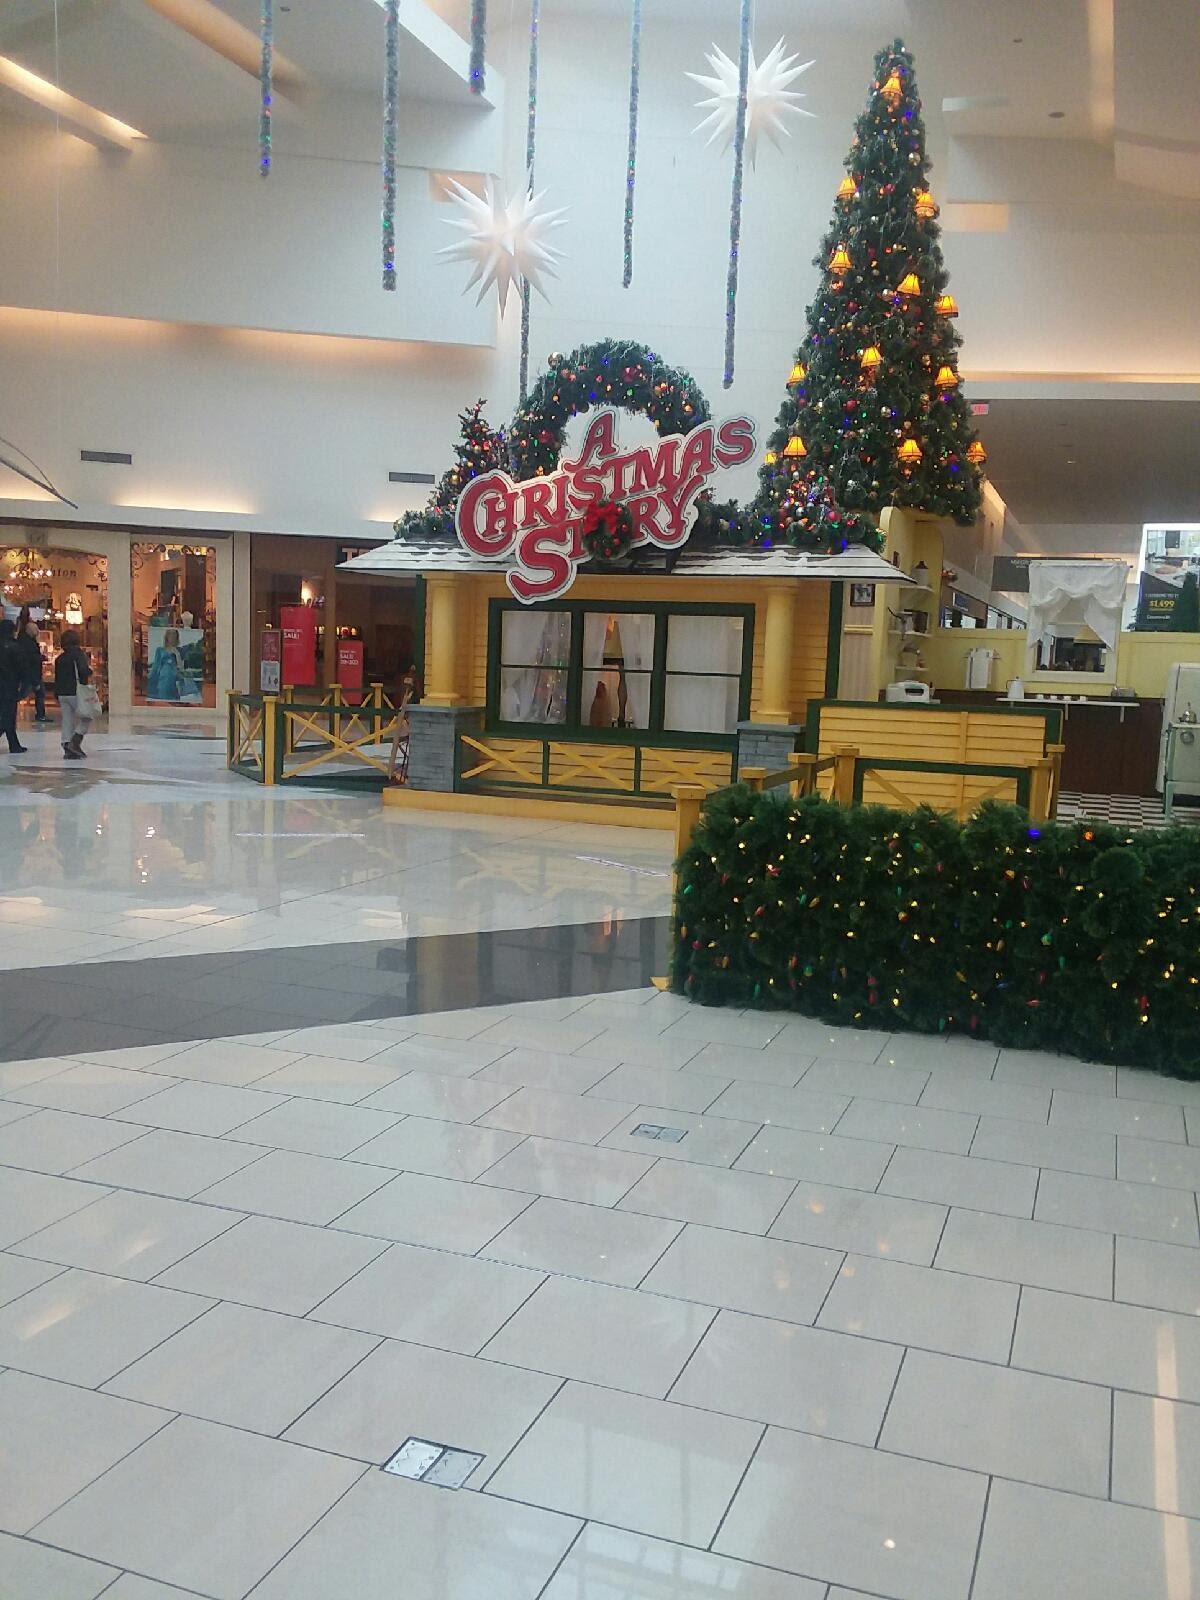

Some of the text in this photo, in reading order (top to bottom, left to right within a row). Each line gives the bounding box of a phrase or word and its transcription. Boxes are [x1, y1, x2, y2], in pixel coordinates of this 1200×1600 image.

[458, 417, 755, 556] CHRISTMAS
[564, 409, 619, 471] A
[509, 475, 704, 598] STRY
